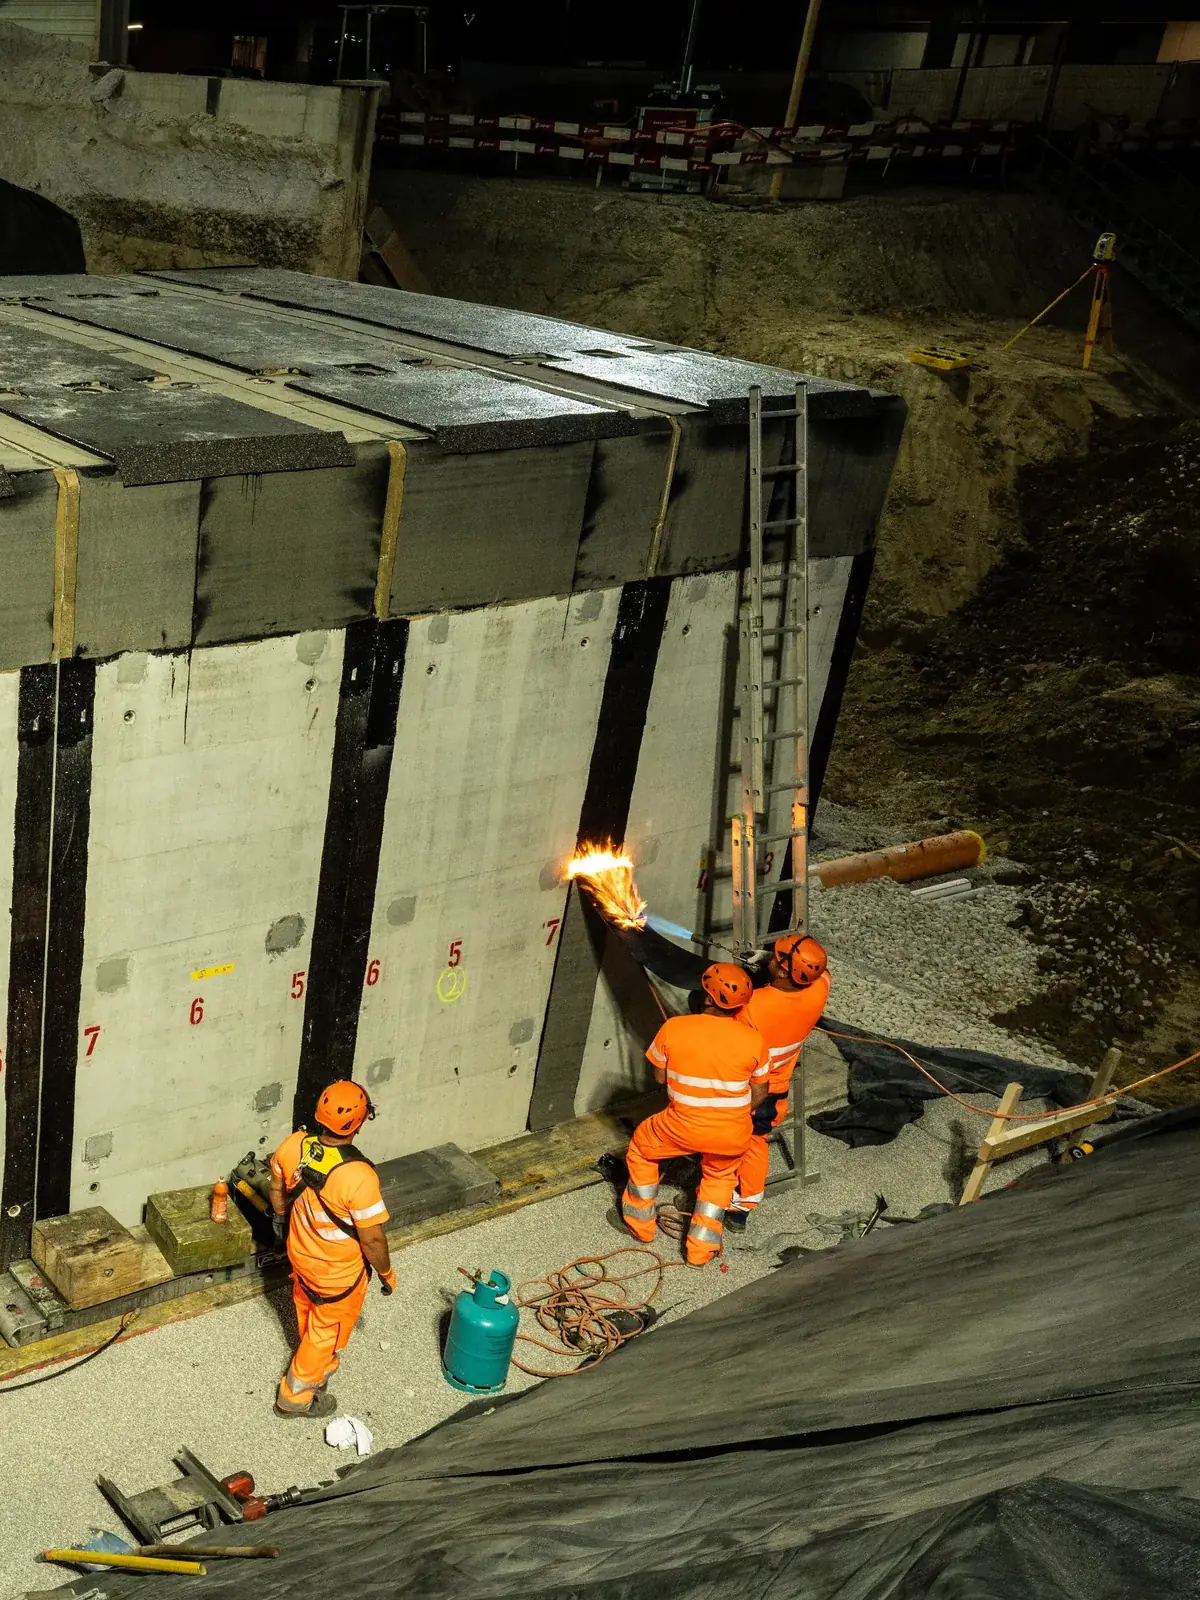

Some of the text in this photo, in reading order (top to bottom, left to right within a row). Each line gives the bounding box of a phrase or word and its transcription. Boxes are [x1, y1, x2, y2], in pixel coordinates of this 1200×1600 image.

[544, 918, 560, 946] 7
[447, 939, 462, 967] 5
[290, 970, 305, 999] 5
[366, 959, 381, 987] 6
[189, 997, 205, 1025] 6
[84, 1025, 101, 1056] 7
